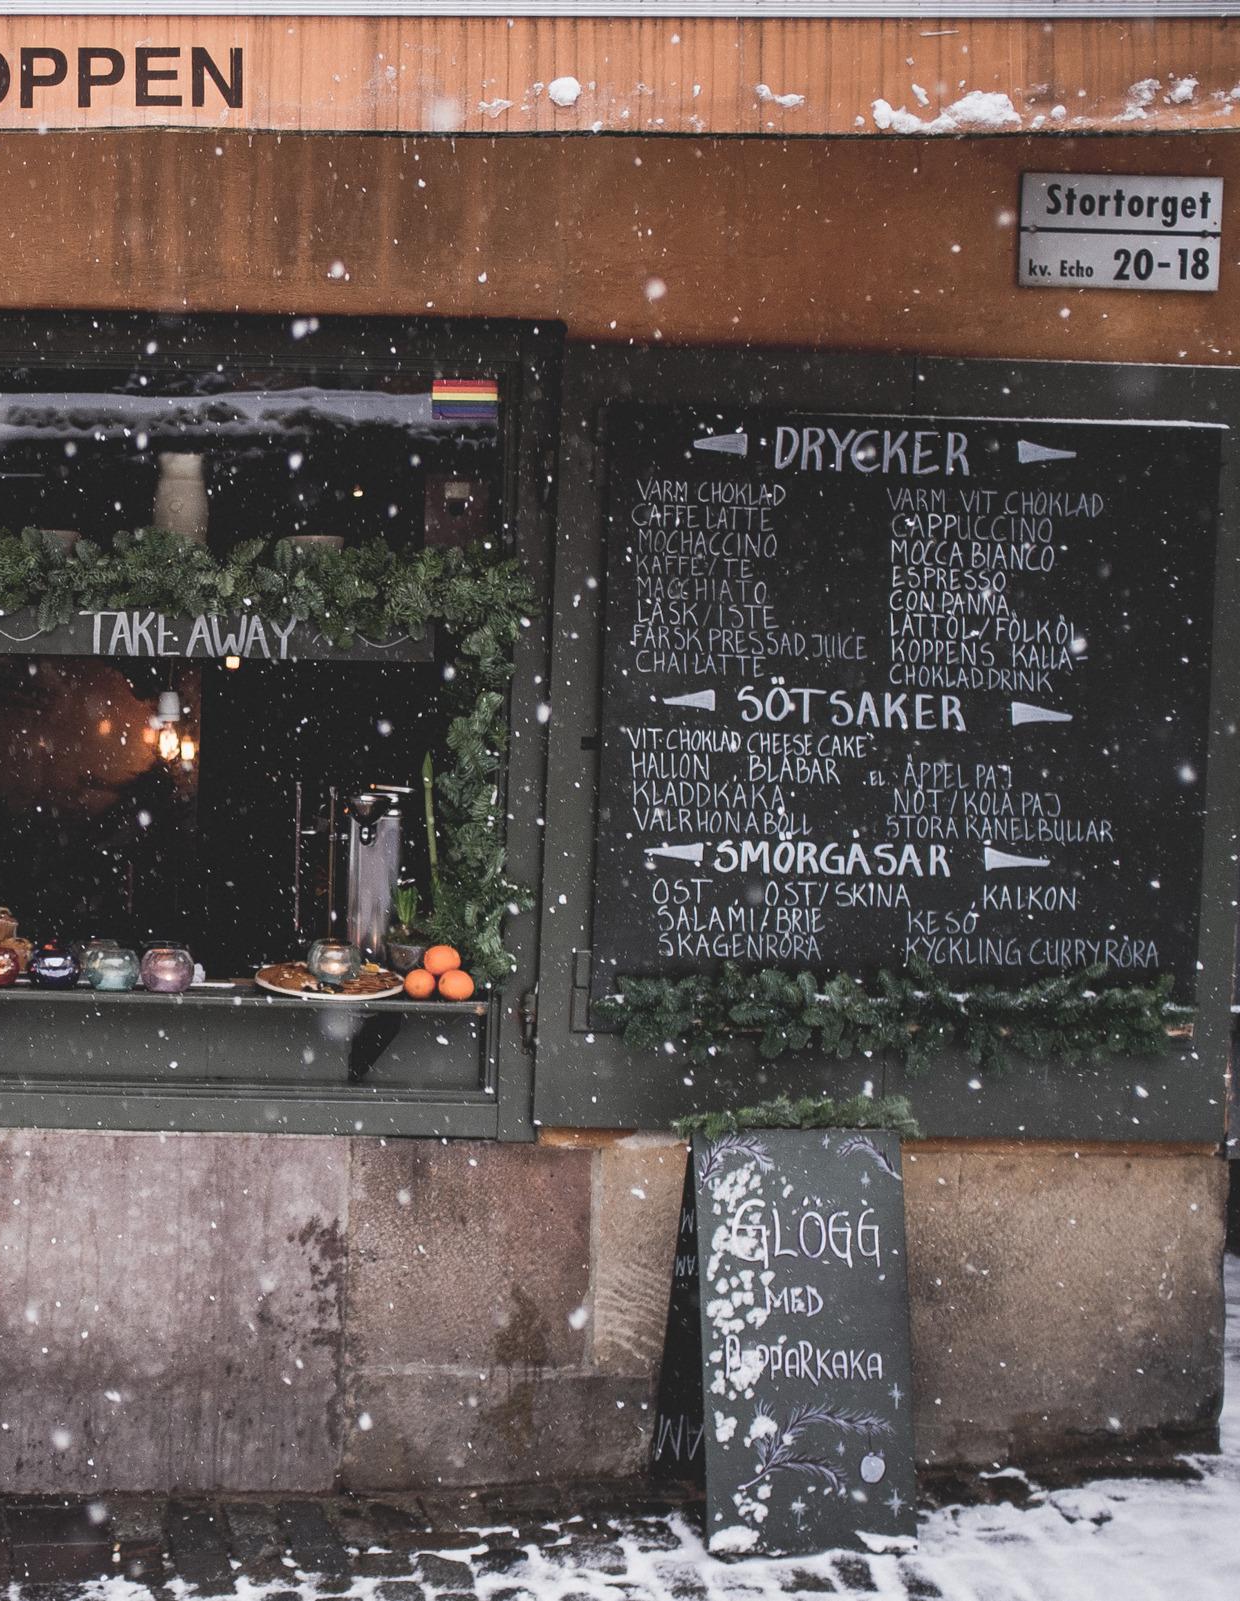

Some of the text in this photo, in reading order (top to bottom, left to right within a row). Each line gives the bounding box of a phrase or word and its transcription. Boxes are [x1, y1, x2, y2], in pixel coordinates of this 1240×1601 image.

[1046, 183, 1211, 228] Stortorget
[1028, 259, 1052, 277] kv.
[1060, 260, 1094, 278] Echo
[774, 426, 970, 476] DRYCKER
[636, 476, 786, 506] VARM CHOKLAD
[887, 488, 1104, 518] VARM VIT CHOKLAD
[631, 503, 774, 532] CAFFE LATTE
[892, 513, 1053, 543] CAPPUCCINO
[638, 529, 778, 558] MOCHACCINO
[891, 539, 1055, 572] MOCCA BIANCO
[636, 576, 767, 604] MACCHIATO
[891, 565, 1006, 592] ESPRESSO
[889, 590, 1010, 616] CON PANNA
[79, 610, 297, 660] TAKE AWAY
[709, 628, 806, 656] PRESSAD
[812, 633, 868, 660] JUICE
[890, 638, 995, 666] KOPPENS
[737, 676, 966, 732] SÖTSAKER
[627, 727, 867, 758] VIT CHOKLAD CHEESE CAKE
[631, 751, 710, 780] HALLON
[632, 780, 785, 810] KLADDKAKA
[886, 815, 1114, 842] STORA KANELBULLAR
[652, 878, 713, 904] OST
[983, 885, 1076, 911] KALKON
[765, 1284, 824, 1317] MED
[726, 1334, 883, 1386] PPPARKAKA
